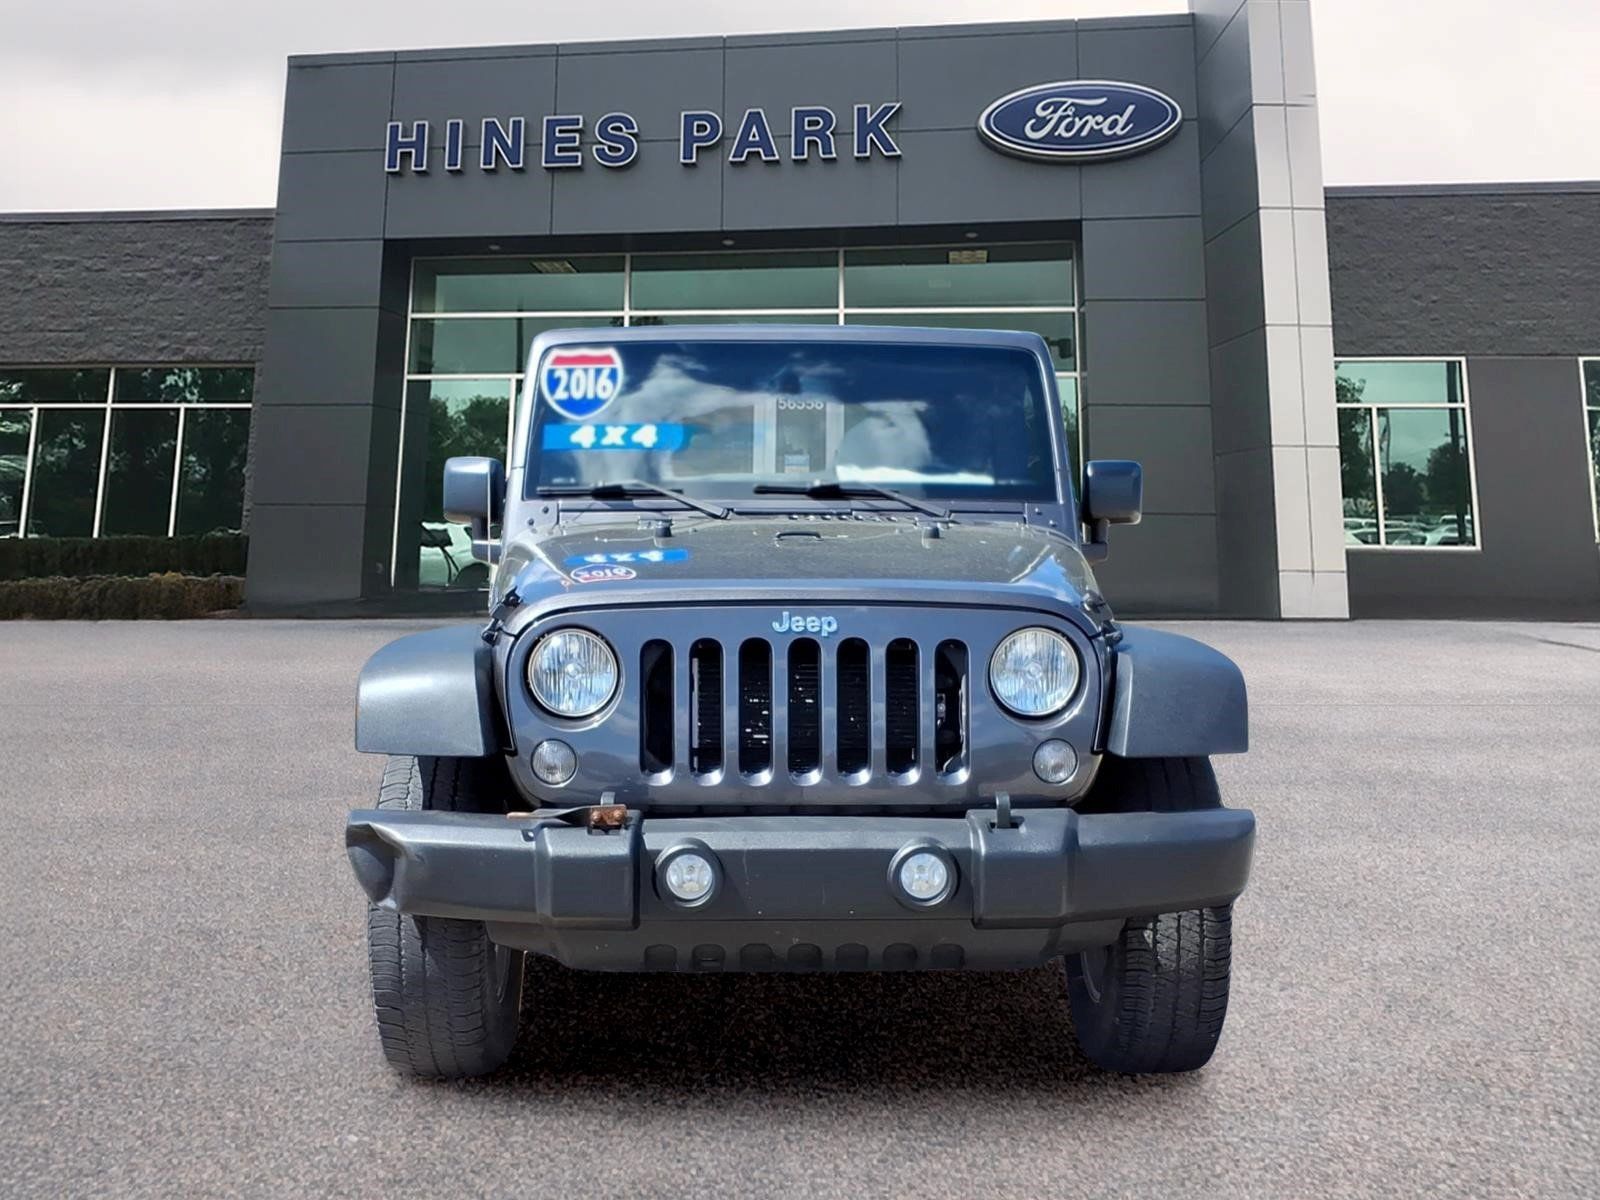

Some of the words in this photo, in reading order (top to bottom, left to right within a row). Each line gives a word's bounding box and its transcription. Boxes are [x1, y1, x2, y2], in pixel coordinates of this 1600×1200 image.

[385, 112, 639, 173] HINES
[680, 102, 903, 164] PARK
[1024, 97, 1136, 140] Ford
[553, 368, 614, 401] 2016
[771, 611, 838, 637] Jeep
